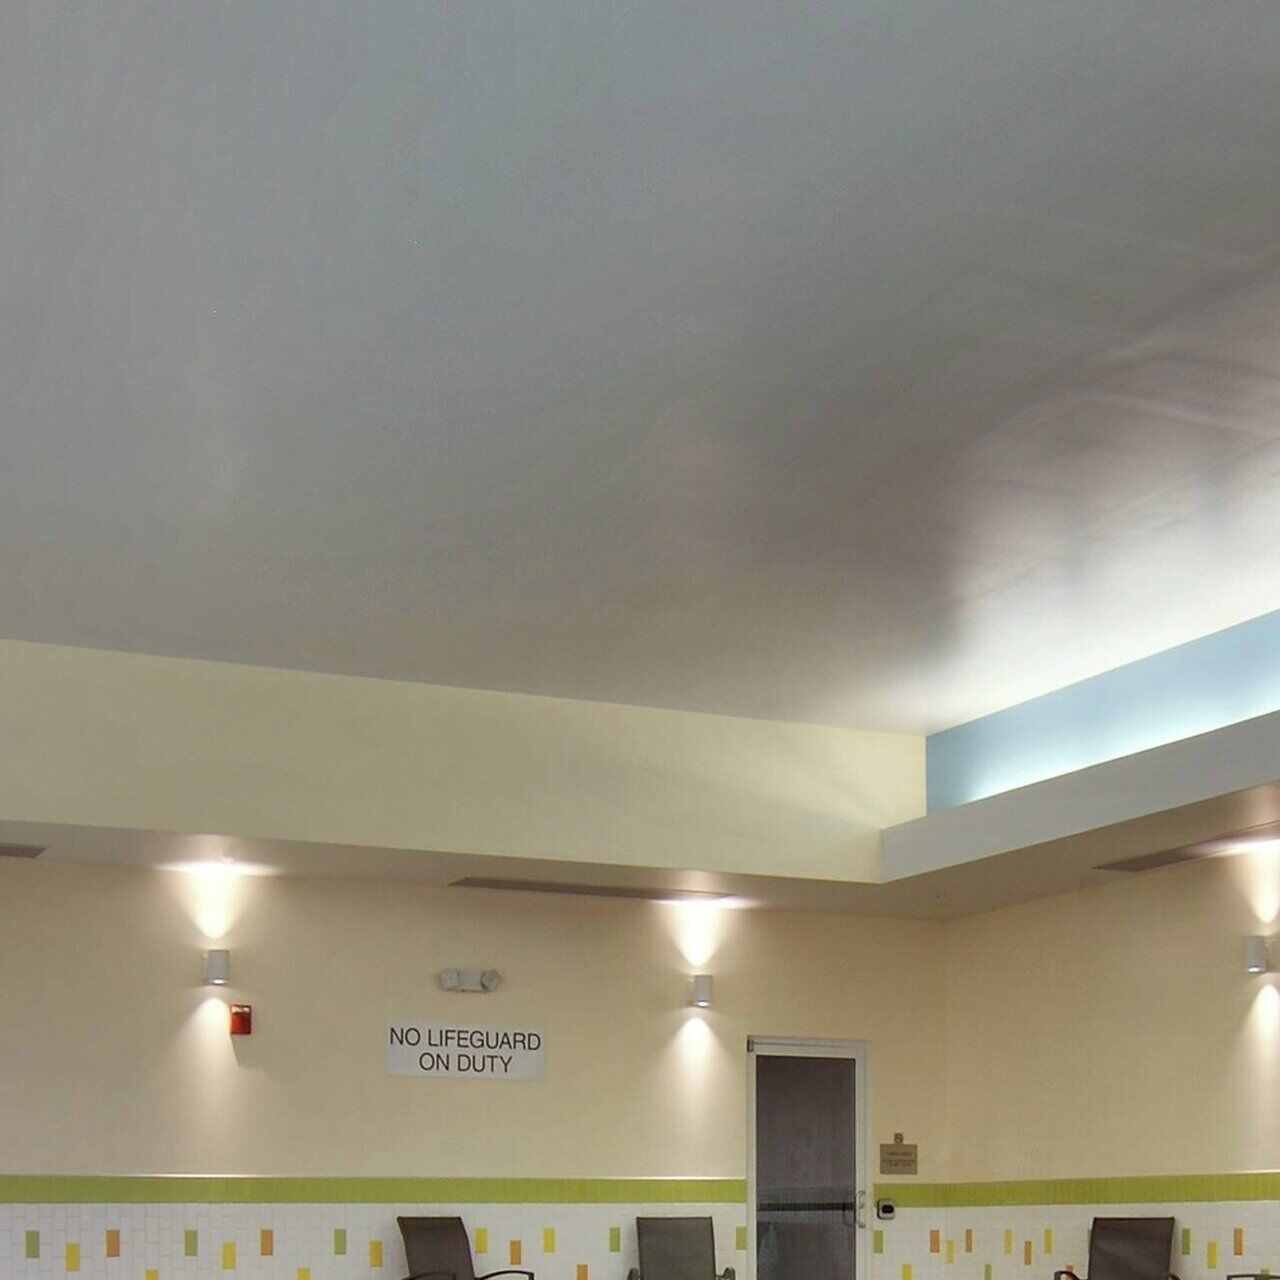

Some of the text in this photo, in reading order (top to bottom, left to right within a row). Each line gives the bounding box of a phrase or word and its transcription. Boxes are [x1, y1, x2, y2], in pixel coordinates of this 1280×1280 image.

[389, 1027, 541, 1051] NO LIFEGUARD
[419, 1052, 513, 1073] ON DUTY
